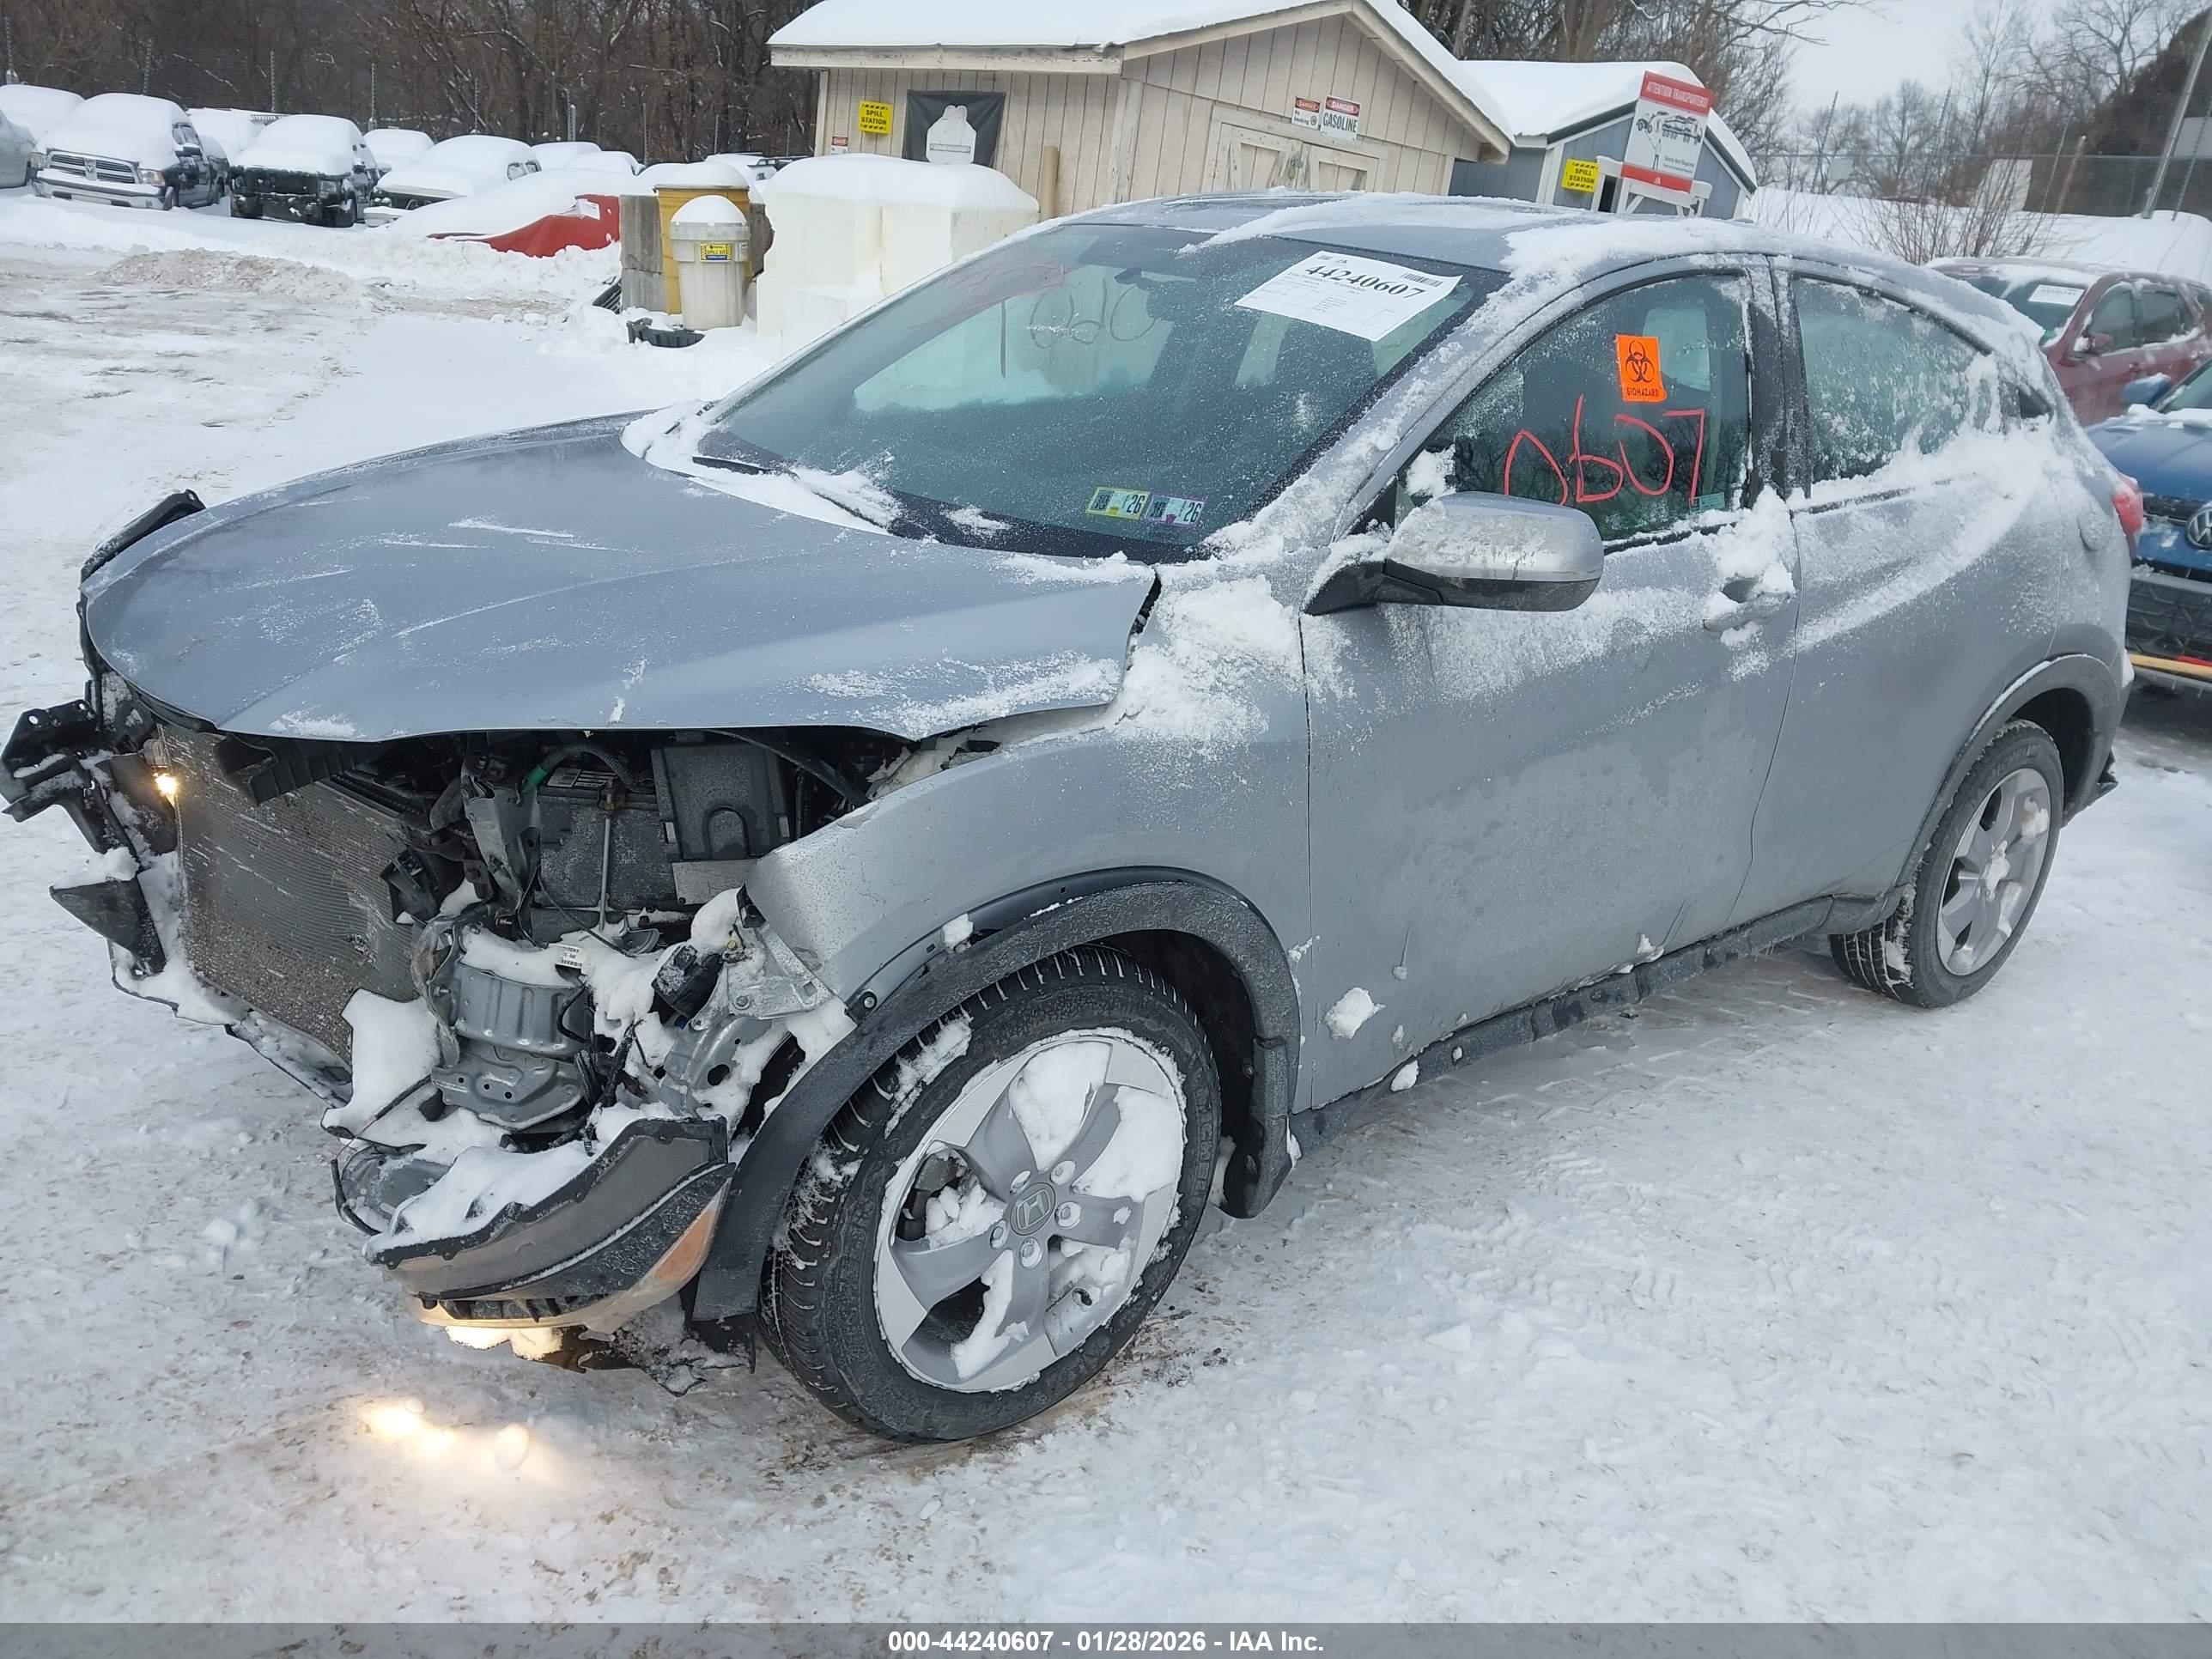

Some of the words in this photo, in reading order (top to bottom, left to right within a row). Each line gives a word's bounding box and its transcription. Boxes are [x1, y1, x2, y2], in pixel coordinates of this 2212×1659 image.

[860, 117, 887, 125] STATION
[1322, 112, 1358, 132] GASOLINE
[1568, 175, 1595, 184] STATION
[1305, 265, 1427, 299] 44240607
[1626, 387, 1659, 397] BIOHAZARD
[1127, 494, 1146, 514] 26
[1183, 501, 1202, 522] 26
